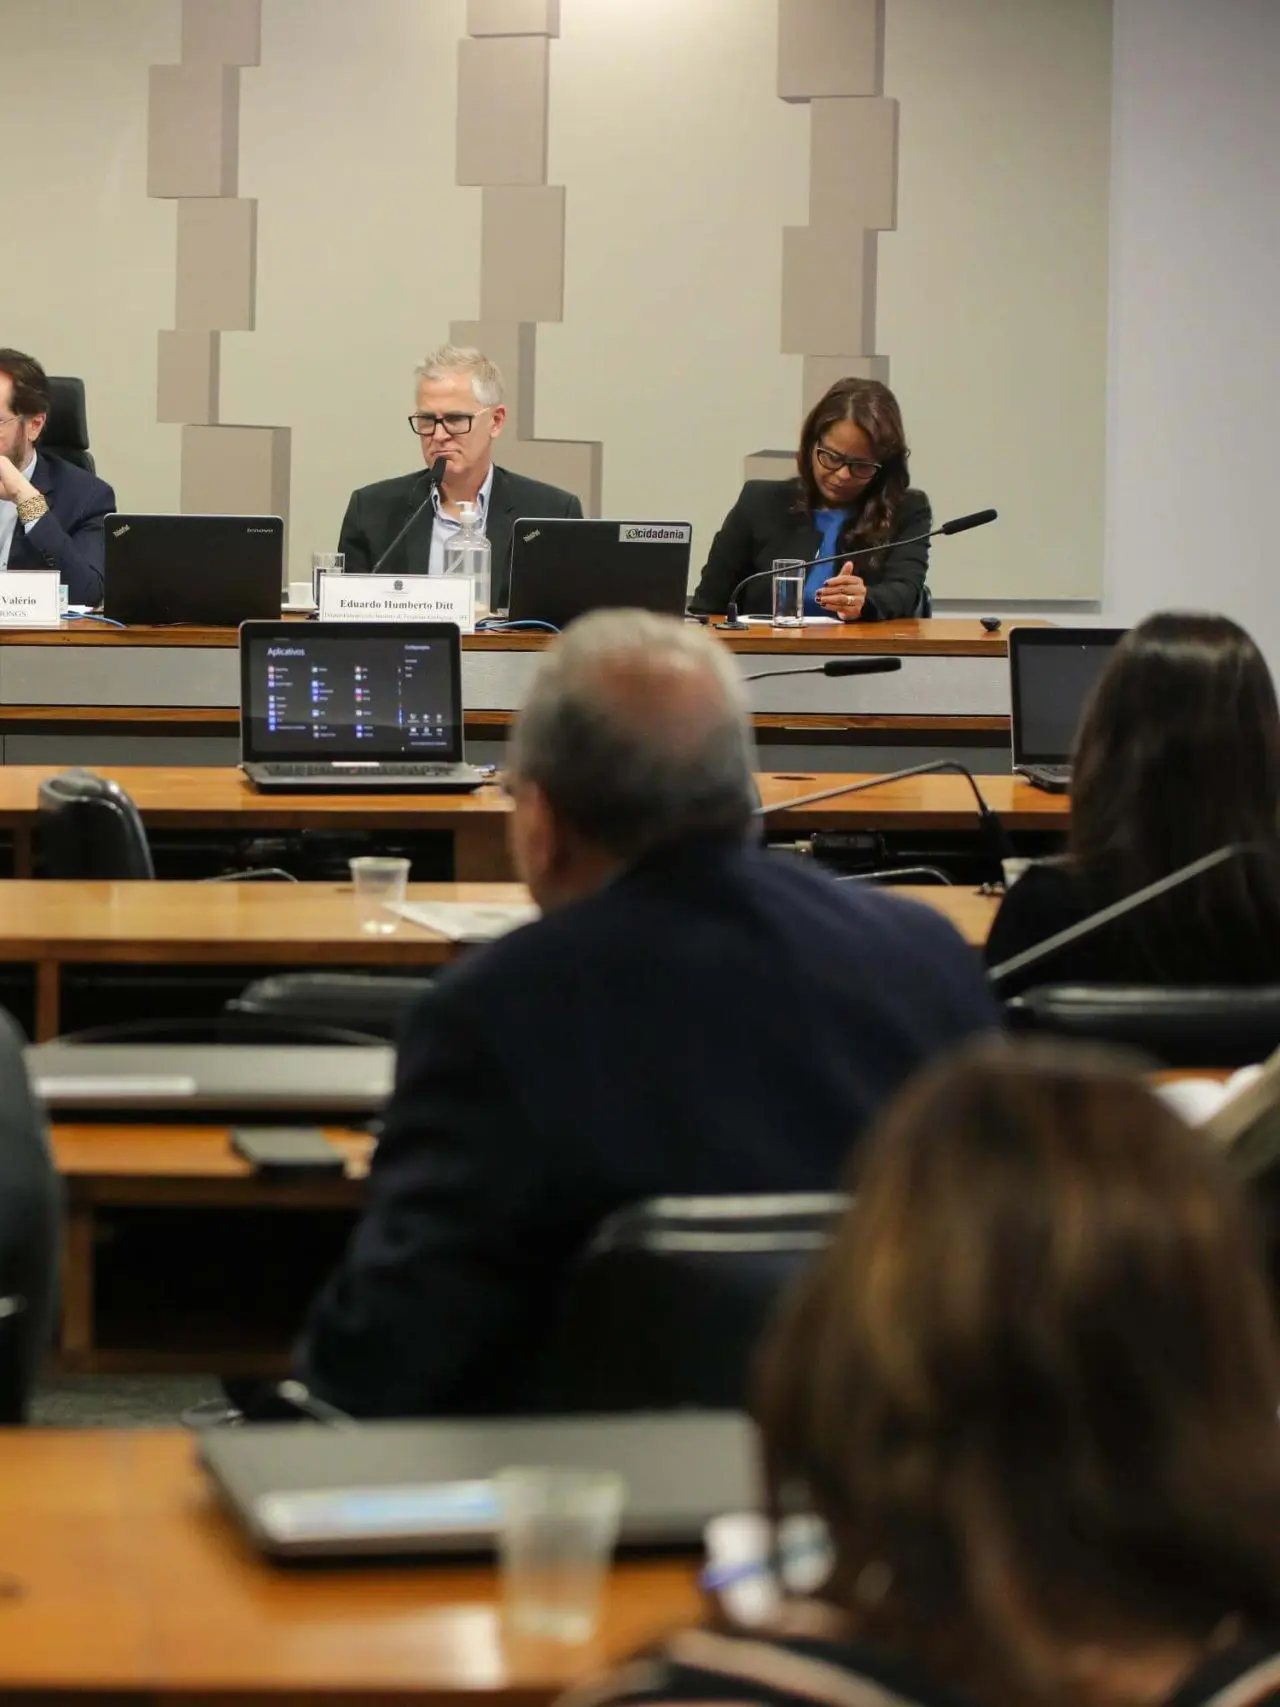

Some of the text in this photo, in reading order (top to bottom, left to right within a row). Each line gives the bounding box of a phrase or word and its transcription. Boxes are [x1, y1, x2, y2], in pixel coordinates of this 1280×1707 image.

[2, 595, 37, 605] Valério
[340, 599, 454, 610] Eduardo Humberto Ditt
[267, 648, 306, 657] Aplicativos
